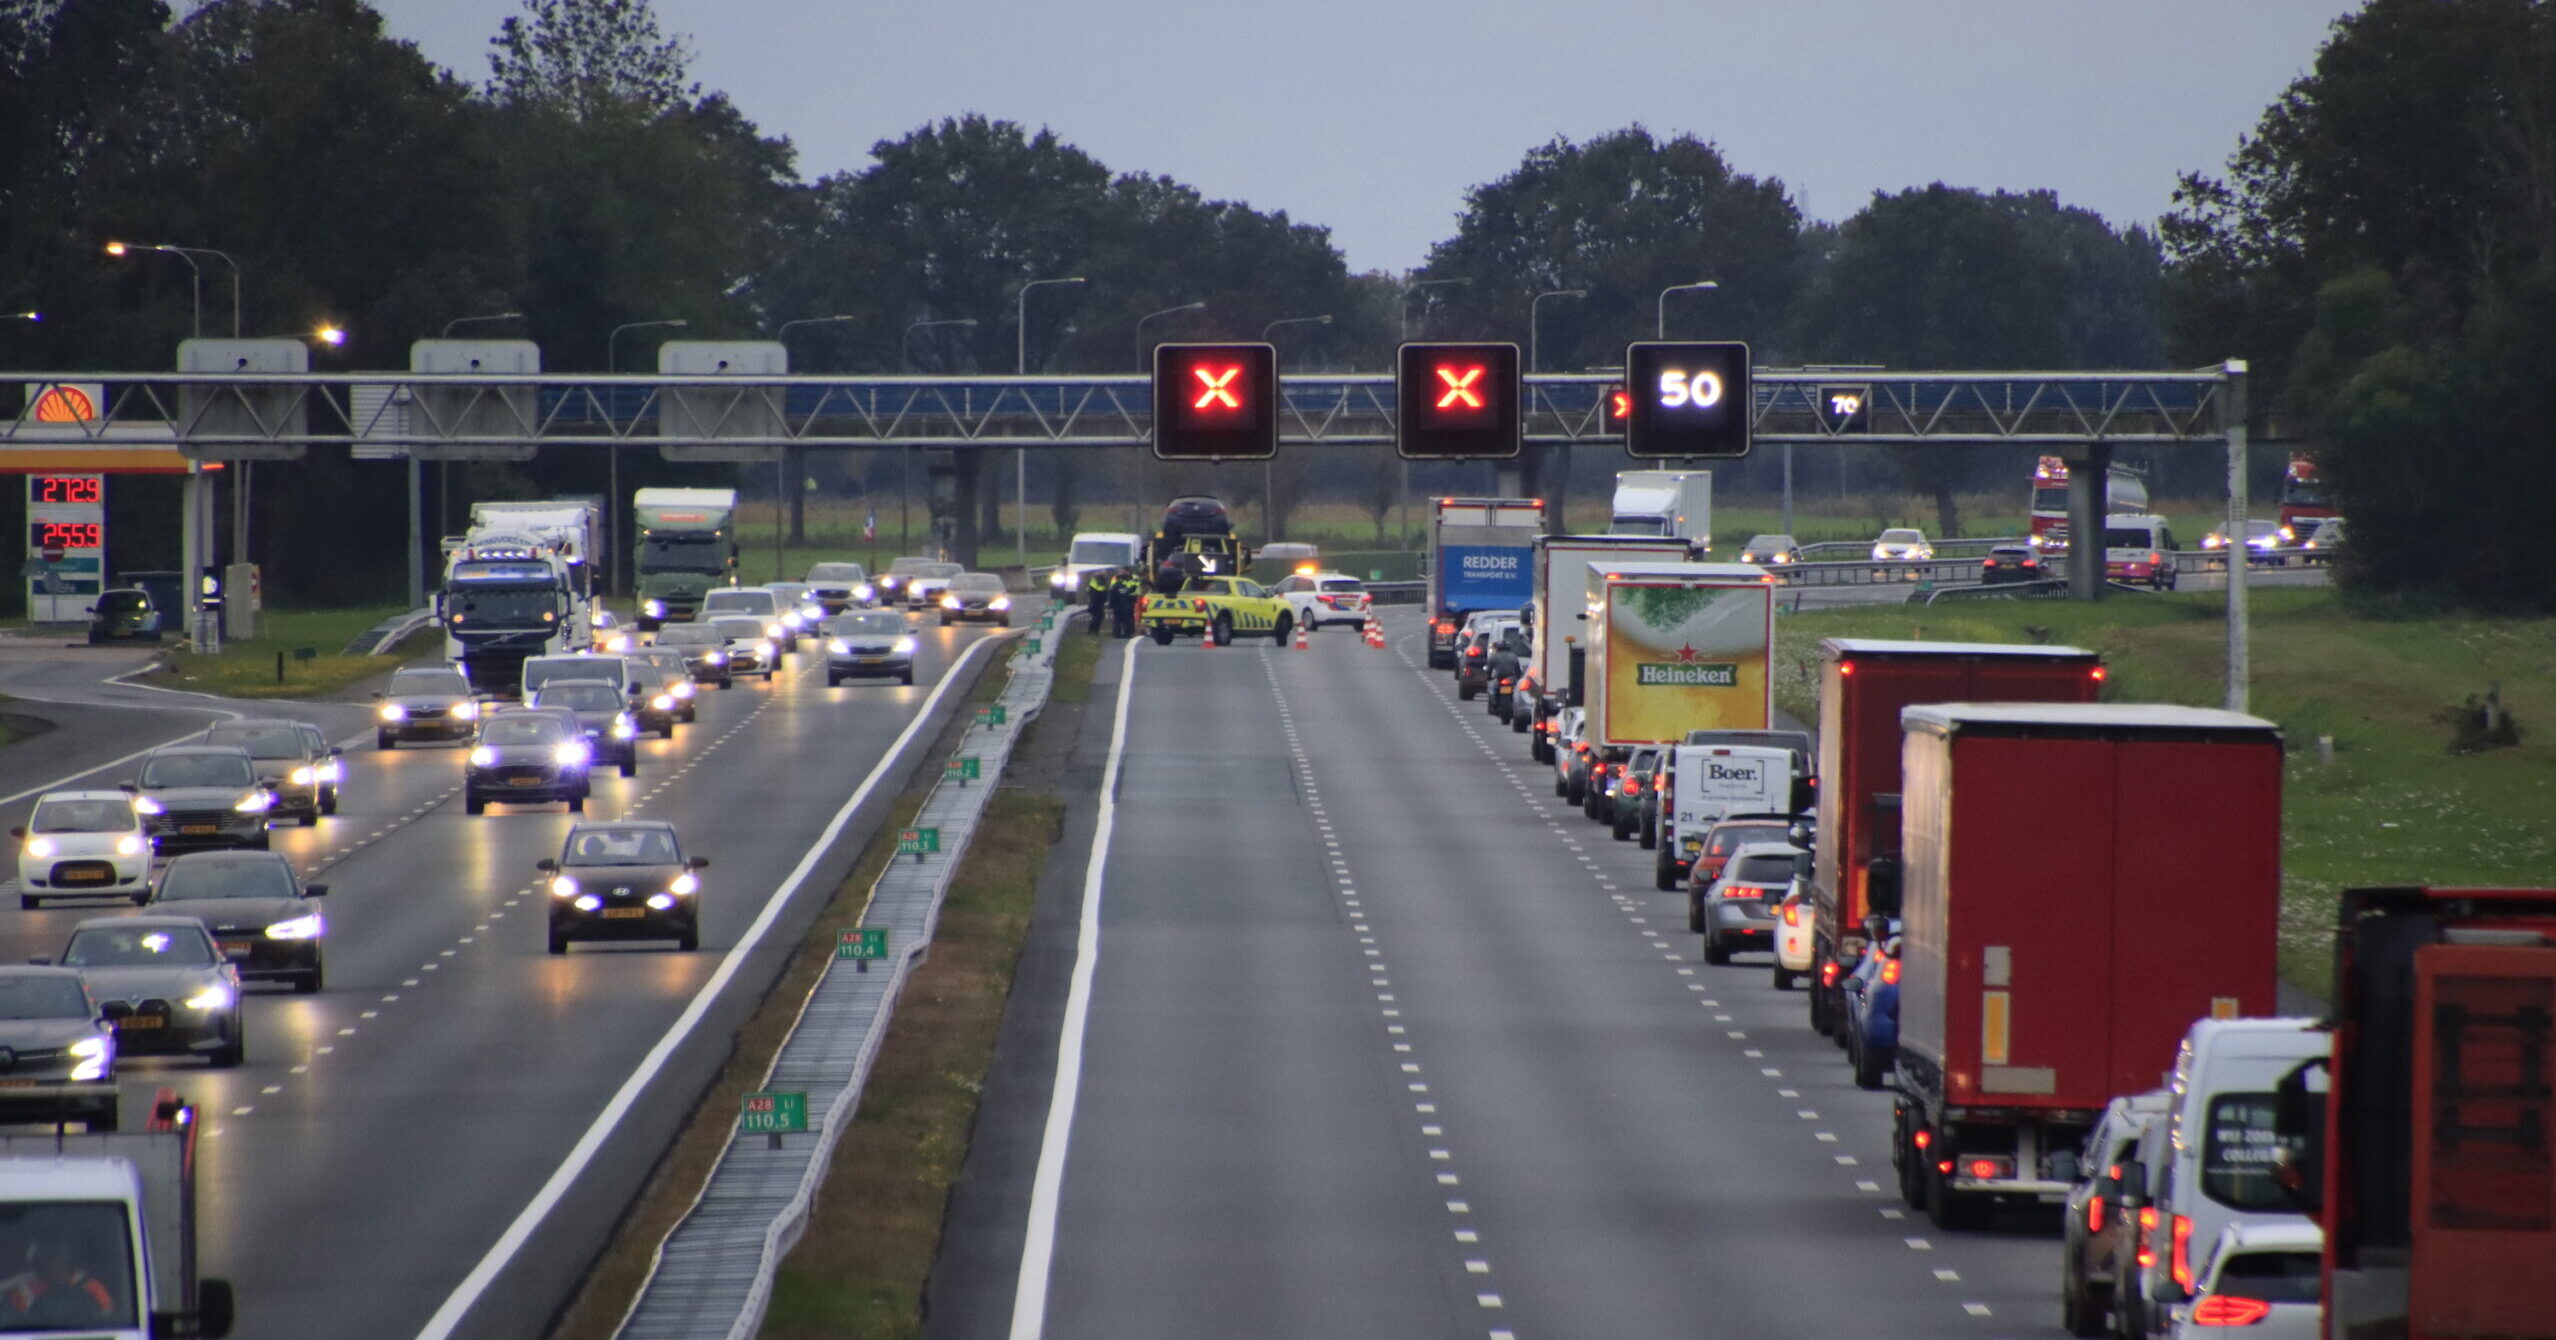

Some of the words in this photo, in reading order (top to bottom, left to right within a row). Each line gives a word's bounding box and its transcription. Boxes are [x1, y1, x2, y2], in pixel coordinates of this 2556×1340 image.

[1659, 370, 1722, 408] 50
[1831, 396, 1860, 414] 70
[1463, 556, 1518, 569] REDDER
[1463, 571, 1503, 579] TRANSPORT
[1642, 665, 1731, 684] Heineken
[1709, 764, 1757, 781] Boer.
[1680, 812, 1693, 822] 21
[842, 933, 861, 943] A28
[748, 1099, 773, 1111] A28
